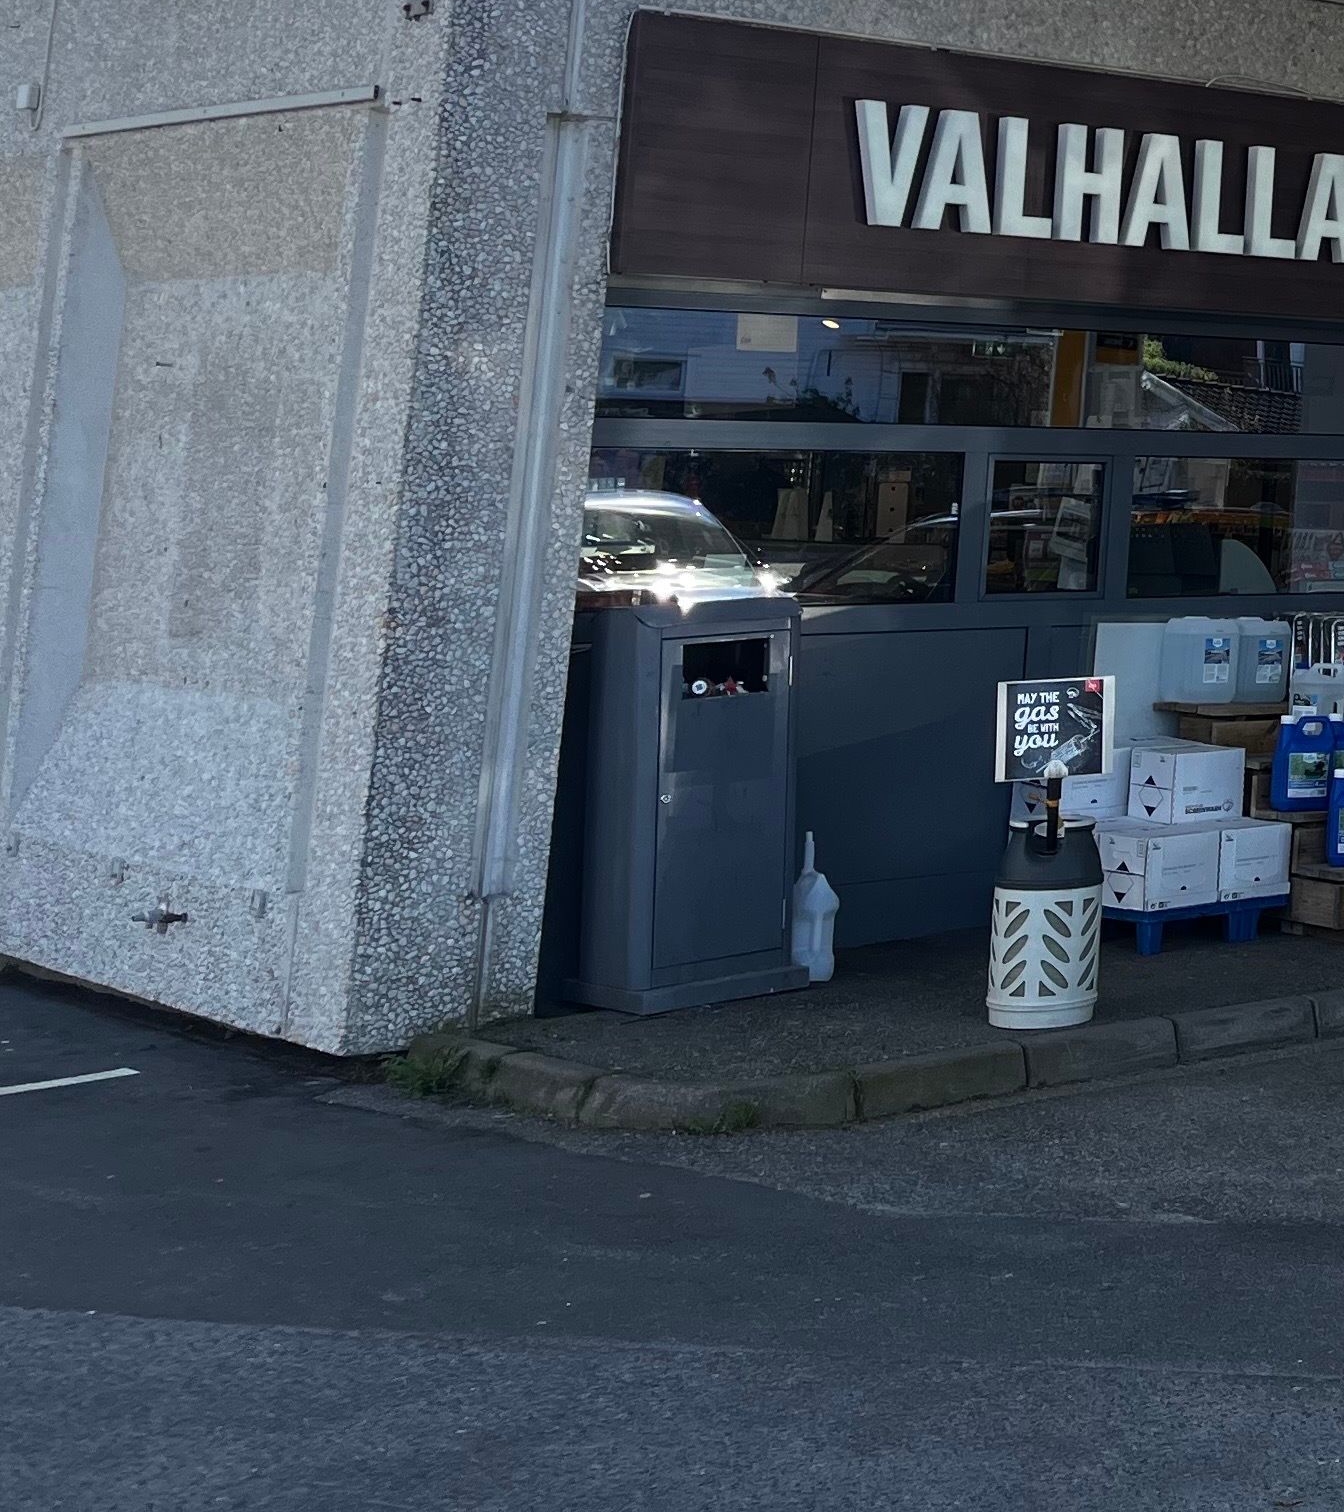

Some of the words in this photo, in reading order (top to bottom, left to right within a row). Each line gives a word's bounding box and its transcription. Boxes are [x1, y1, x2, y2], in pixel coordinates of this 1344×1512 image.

[1017, 692, 1038, 705] MAY
[1039, 691, 1060, 704] THE
[1014, 705, 1060, 730] gas
[1028, 723, 1039, 734] BE
[1040, 722, 1060, 732] WITH
[1013, 734, 1059, 756] you
